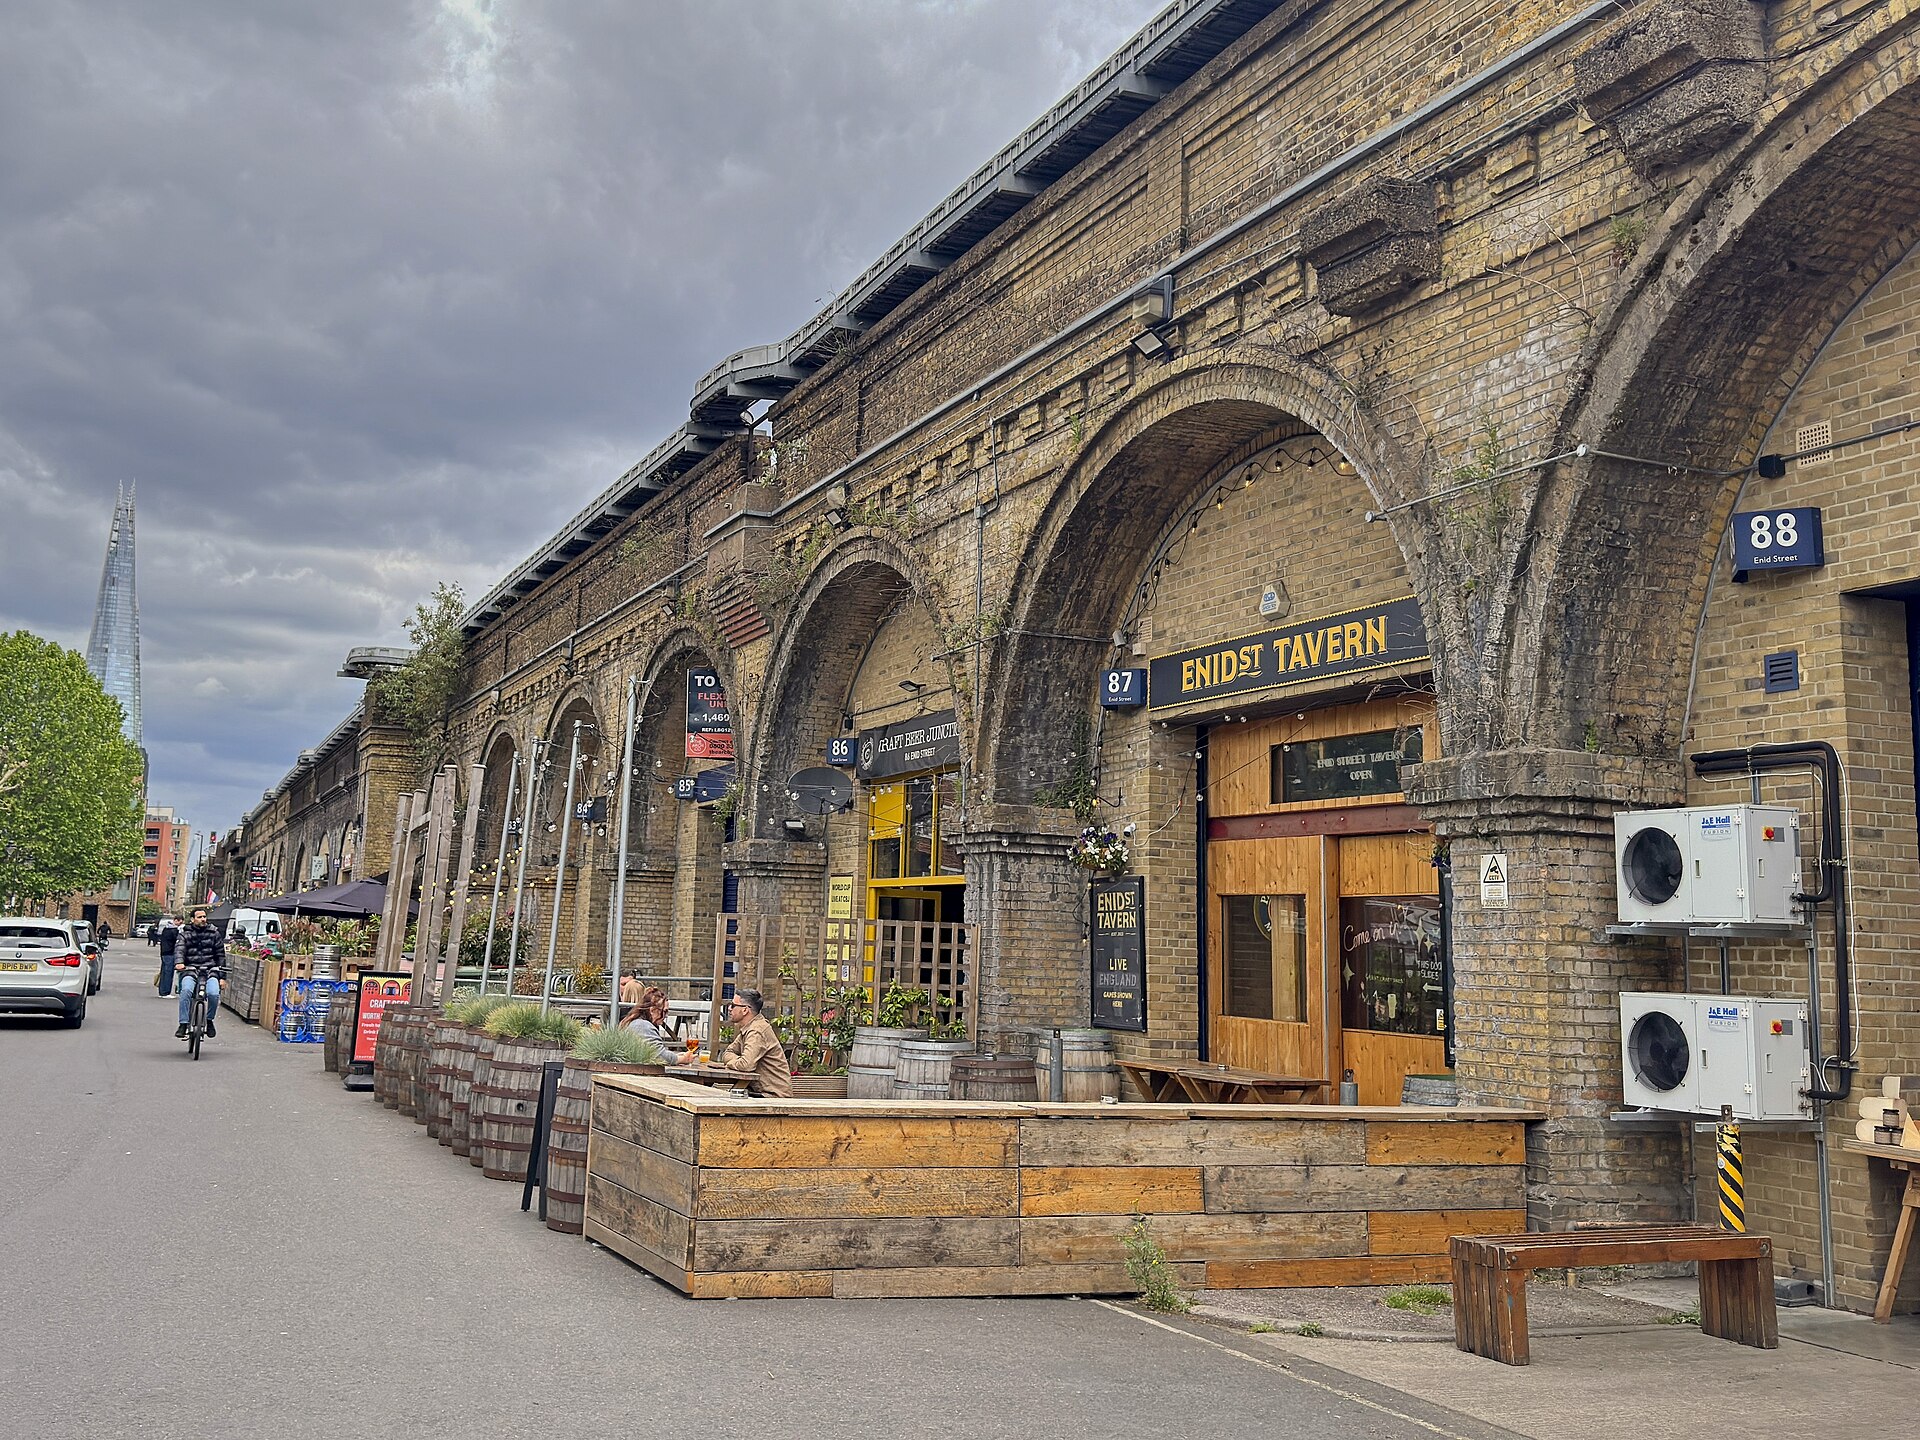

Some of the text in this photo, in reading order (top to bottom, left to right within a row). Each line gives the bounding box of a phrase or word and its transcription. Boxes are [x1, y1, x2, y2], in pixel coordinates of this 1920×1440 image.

[1750, 512, 1798, 549] 88
[1753, 554, 1798, 564] Enid Street
[1181, 650, 1238, 693] ENID
[1273, 615, 1389, 674] TAVERN
[694, 675, 716, 687] TO
[1108, 671, 1132, 693] 87
[904, 729, 926, 747] BEER
[832, 740, 848, 756] 86
[920, 747, 936, 758] STREET
[1337, 754, 1366, 766] STREET
[1349, 769, 1373, 780] OPEN
[679, 779, 691, 791] 85
[577, 803, 588, 813] 84
[1715, 815, 1731, 824] Hall
[1097, 892, 1124, 912] ENID
[1097, 911, 1137, 929] TAVERN
[1343, 924, 1371, 952] Come
[1373, 926, 1386, 942] on
[1109, 958, 1128, 971] LIVE
[1417, 960, 1443, 971] THIS DOO
[1099, 973, 1137, 987] ENGLAND
[1421, 969, 1440, 981] SLIDES
[1103, 991, 1117, 999] GAMES
[1722, 1007, 1738, 1015] Hall
